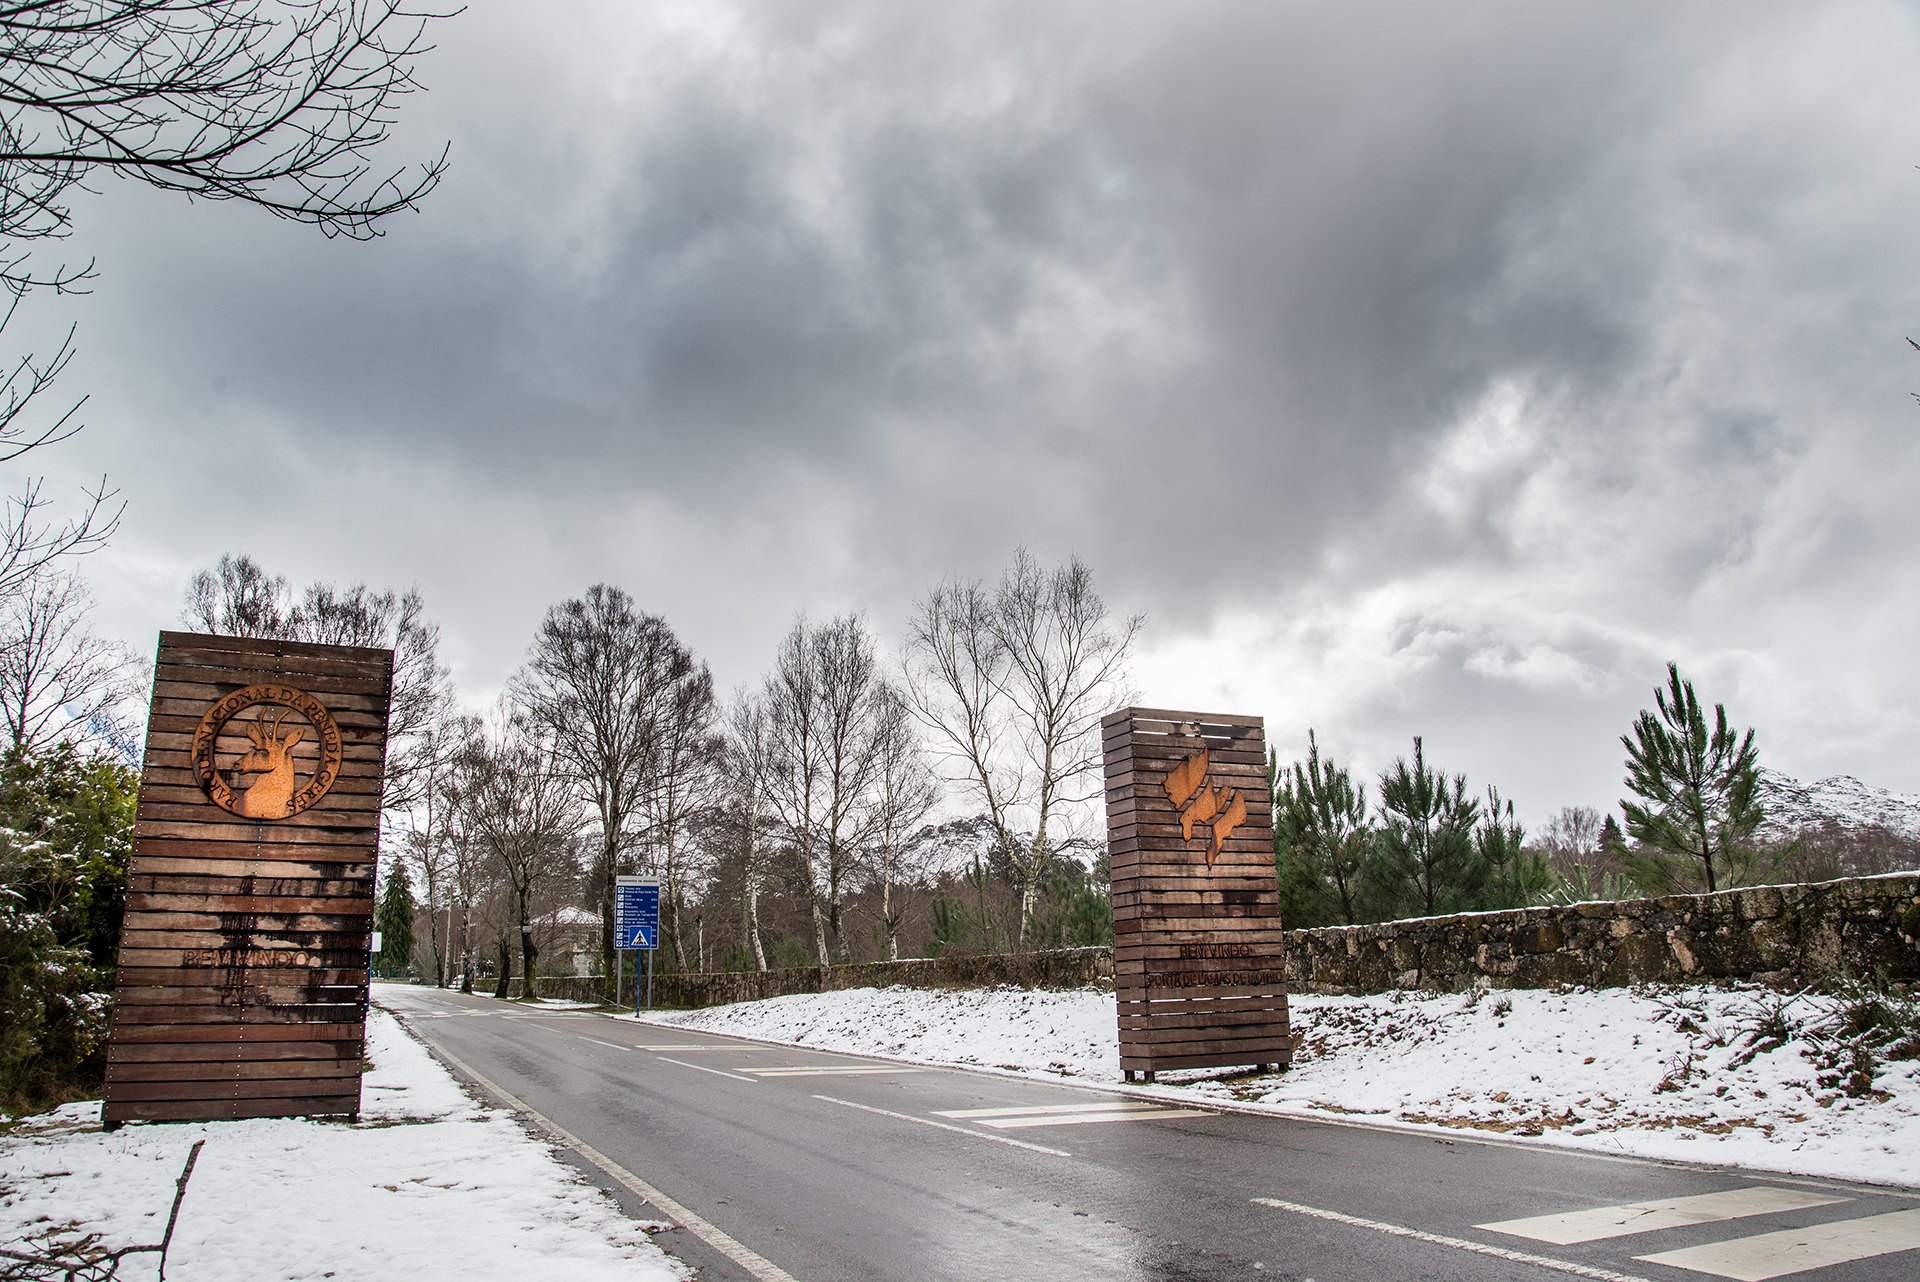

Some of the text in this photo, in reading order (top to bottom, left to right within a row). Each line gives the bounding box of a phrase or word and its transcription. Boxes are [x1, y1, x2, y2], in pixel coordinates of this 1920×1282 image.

[278, 688, 303, 707] DA
[198, 687, 277, 743] NACIONAL
[196, 747, 238, 807] PARQUE
[183, 949, 309, 968] BEM VINDO
[1180, 944, 1251, 958] BEM VINDO
[1148, 971, 1283, 987] PORTA DE LAMAS DE MOURO
